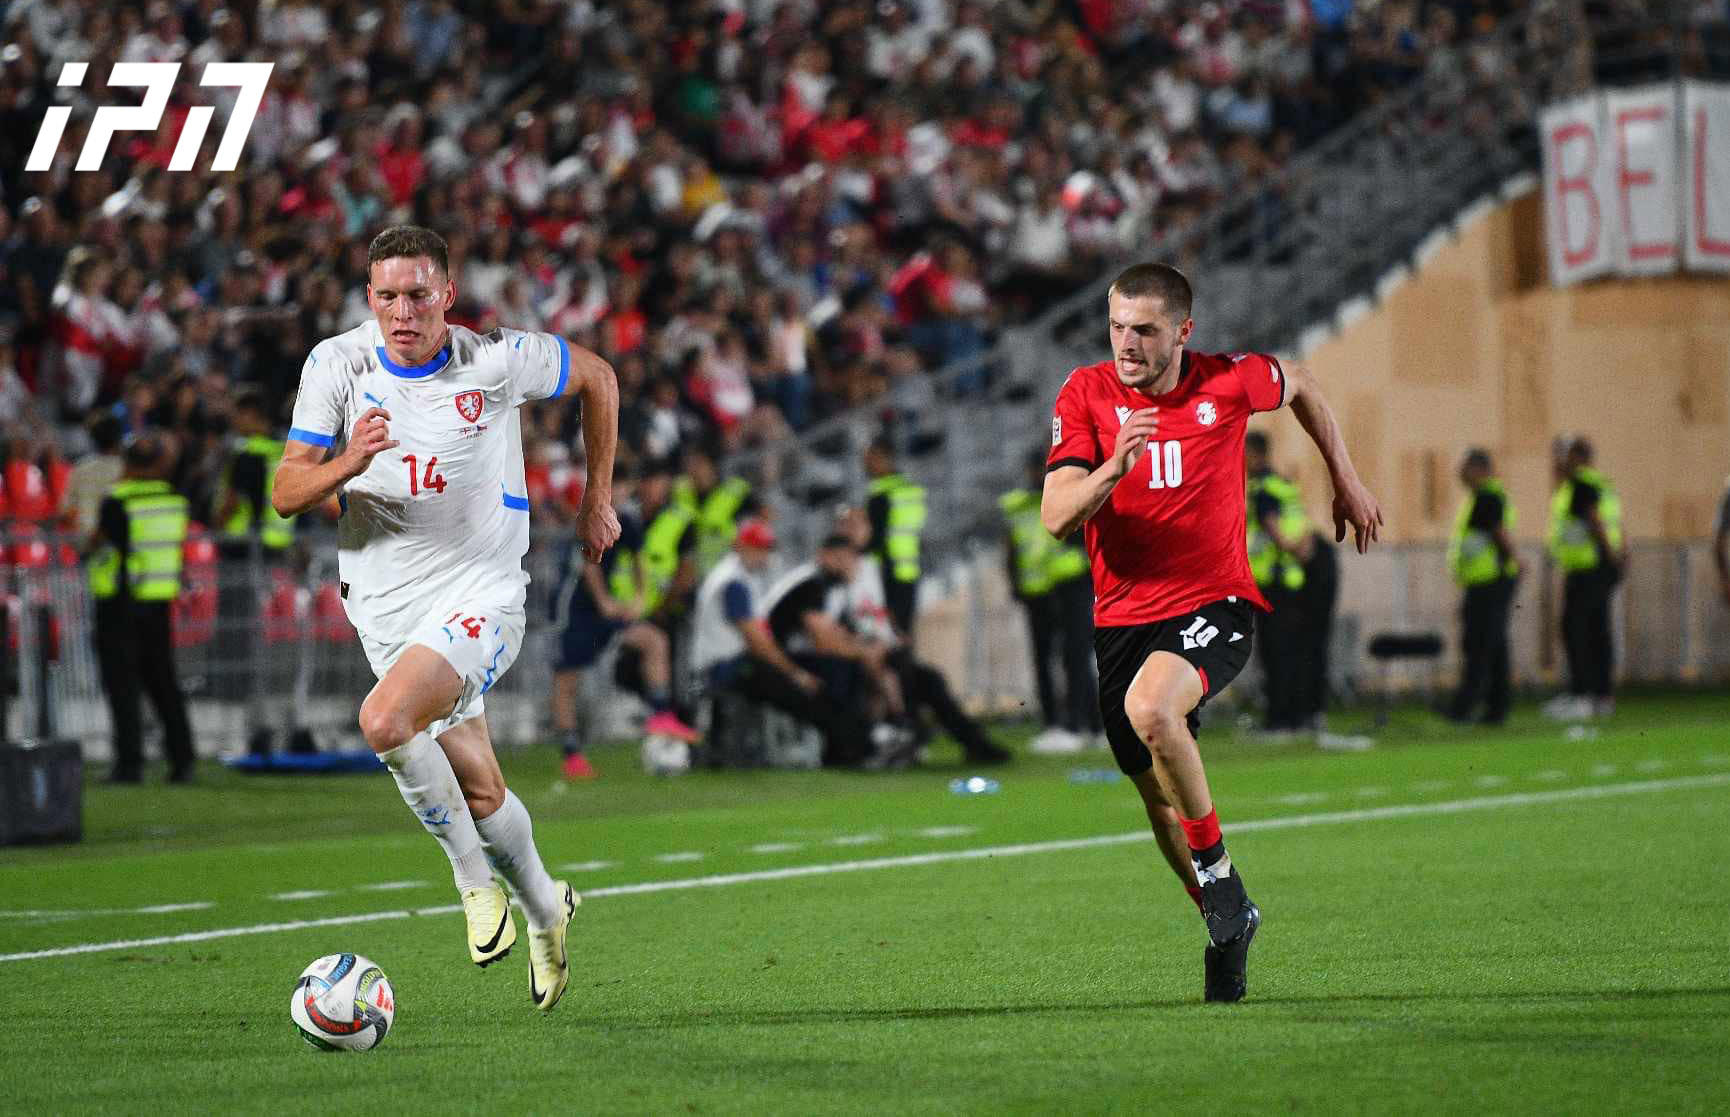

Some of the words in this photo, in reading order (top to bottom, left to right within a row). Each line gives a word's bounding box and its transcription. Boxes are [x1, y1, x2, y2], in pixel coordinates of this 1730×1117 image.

[401, 454, 448, 496] 14
[1146, 440, 1183, 489] 10
[1179, 615, 1220, 648] 10
